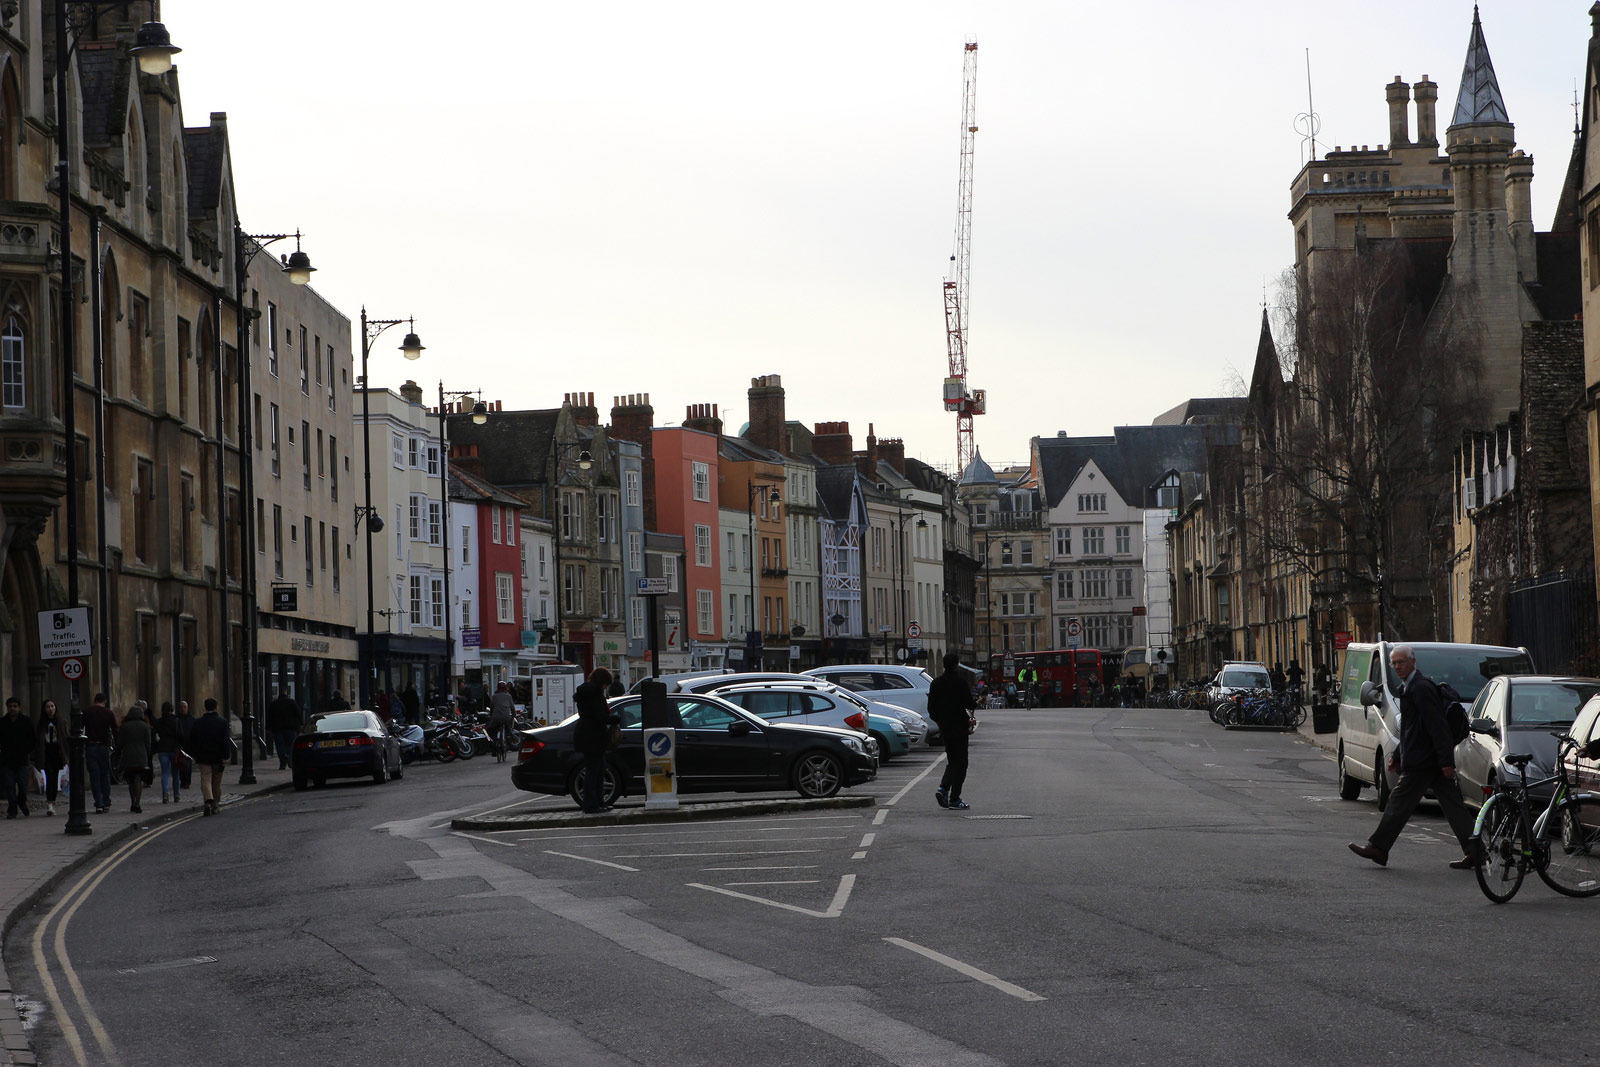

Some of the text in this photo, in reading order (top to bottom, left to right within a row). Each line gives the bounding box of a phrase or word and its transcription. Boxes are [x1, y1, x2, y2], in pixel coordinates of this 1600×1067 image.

[52, 632, 76, 640] Traffic
[668, 626, 678, 646] i
[44, 640, 87, 649] enforcement
[50, 648, 81, 657] cameras
[64, 664, 82, 674] 20
